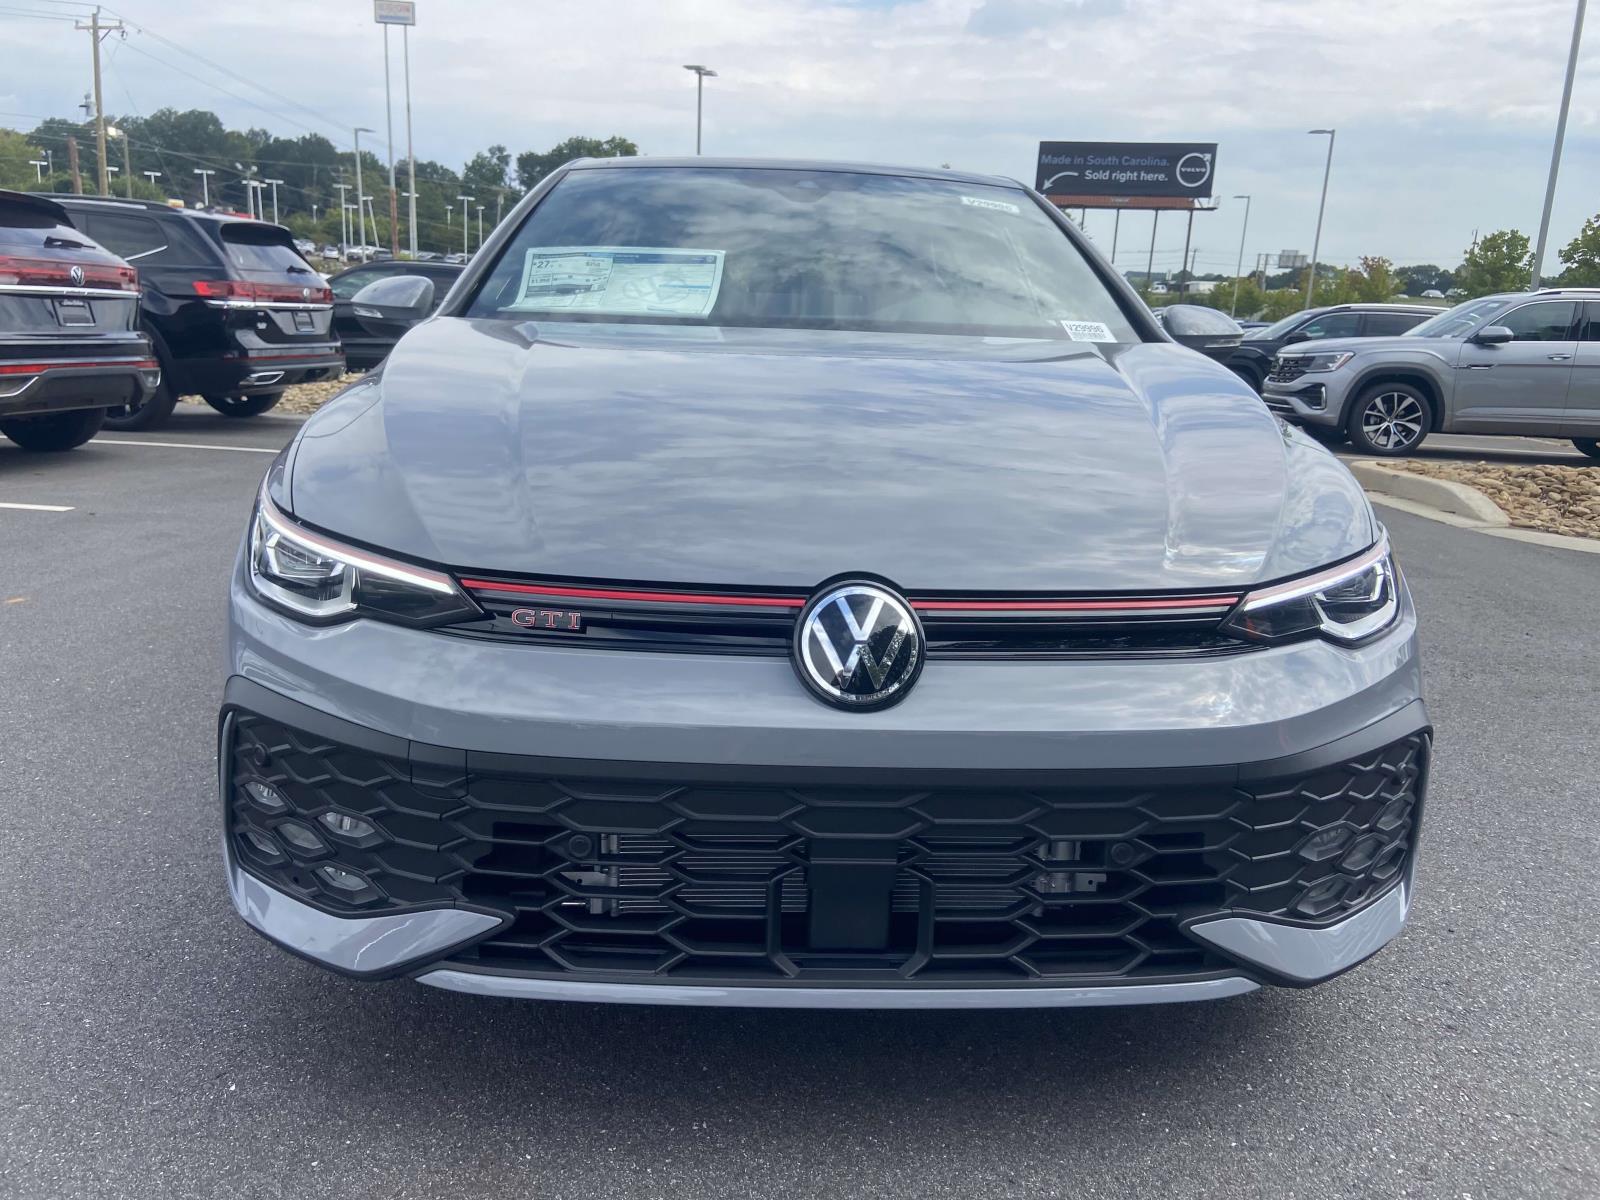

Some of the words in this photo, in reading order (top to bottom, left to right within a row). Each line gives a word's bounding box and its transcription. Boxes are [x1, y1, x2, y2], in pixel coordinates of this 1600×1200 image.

[1041, 155, 1071, 165] Made
[1074, 154, 1084, 165] in
[1086, 155, 1119, 166] South
[1121, 156, 1170, 167] Carolina.
[1084, 170, 1109, 180] Sold
[1112, 171, 1138, 183] right
[1140, 172, 1169, 182] here.
[511, 608, 581, 630] GTI
